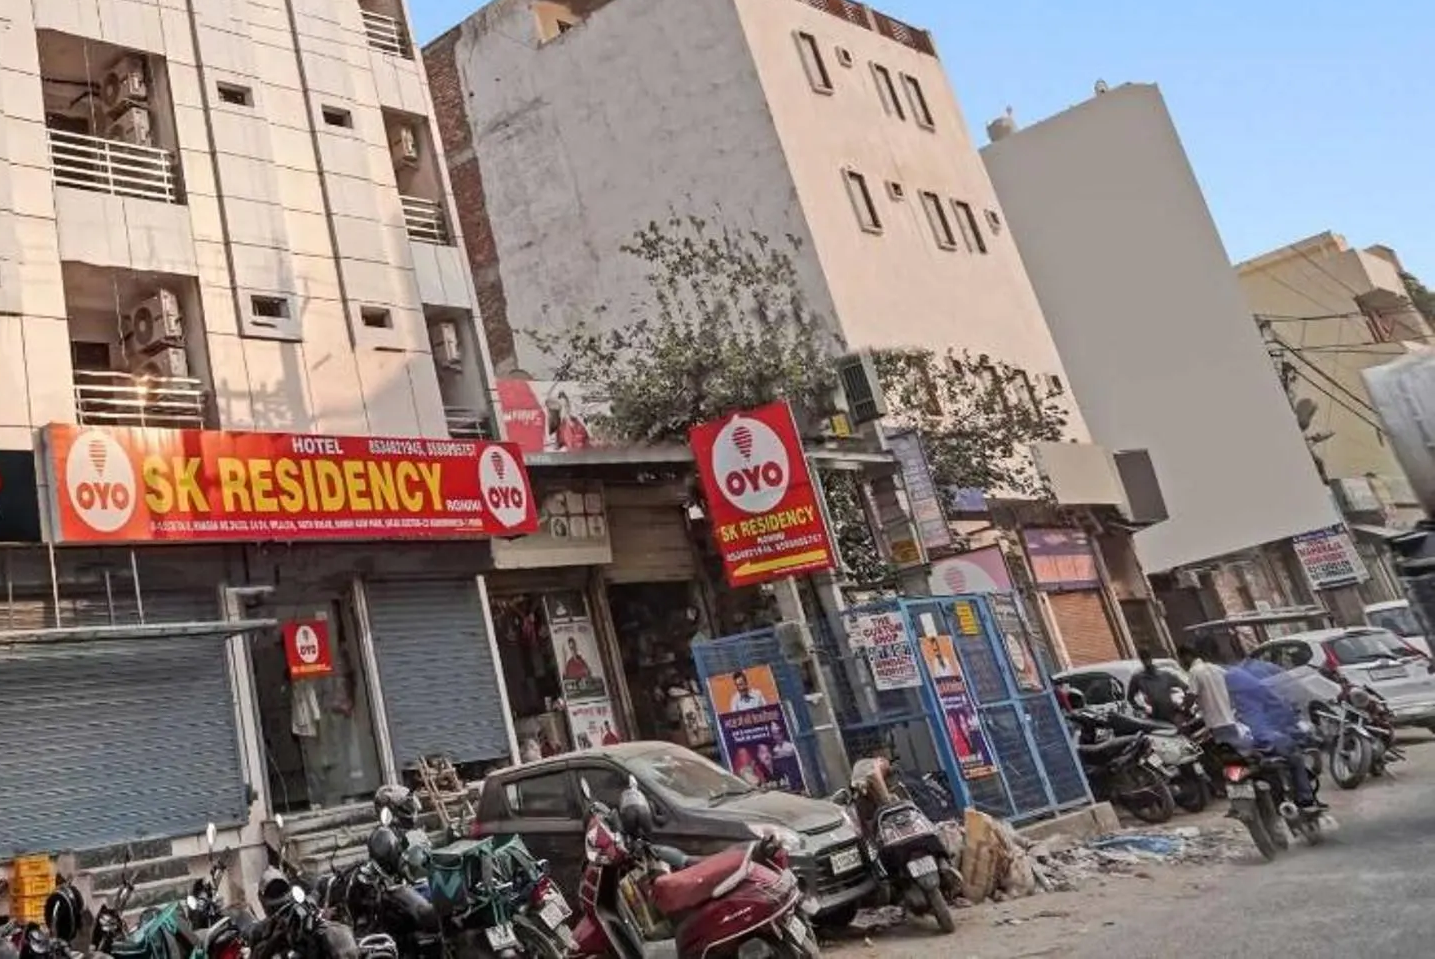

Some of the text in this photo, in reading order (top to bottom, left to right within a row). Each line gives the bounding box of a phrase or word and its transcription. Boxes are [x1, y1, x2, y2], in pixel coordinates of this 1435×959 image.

[292, 438, 344, 455] HOTEL
[143, 456, 444, 514] SK RESIDENCY
[725, 461, 783, 497] OYO
[75, 482, 130, 510] OYO
[487, 486, 523, 510] OYO
[720, 525, 739, 542] SK
[741, 505, 814, 538] RESIDENCY
